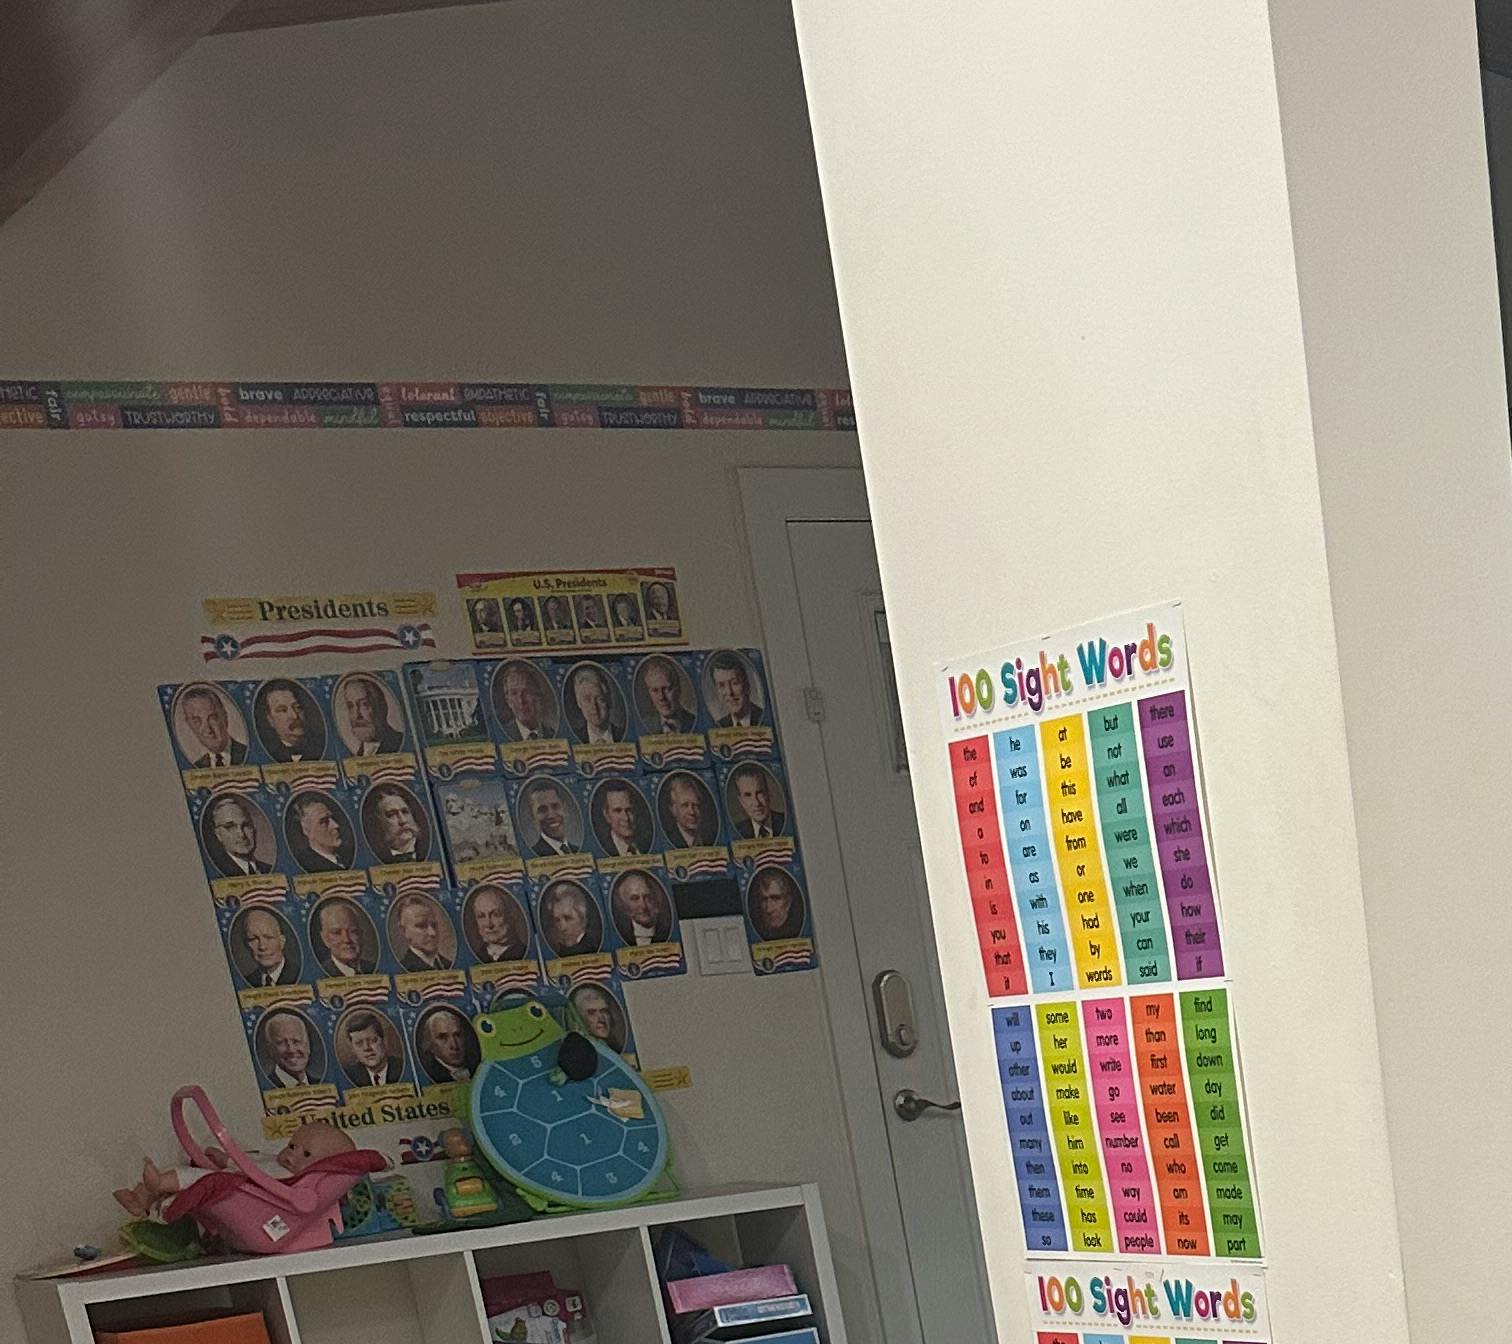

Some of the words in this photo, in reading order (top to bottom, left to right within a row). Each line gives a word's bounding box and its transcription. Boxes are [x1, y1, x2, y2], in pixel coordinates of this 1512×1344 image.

[239, 385, 283, 401] brave
[401, 385, 457, 402] tolerant
[699, 390, 736, 405] brave
[404, 408, 477, 427] respectful
[532, 578, 553, 590] U.S.
[555, 577, 608, 590] Presidents
[258, 599, 390, 622] Presidents
[947, 667, 994, 718] 100
[1000, 649, 1072, 713] Sight
[1076, 623, 1173, 686] Words
[1104, 715, 1118, 731] but
[1009, 737, 1020, 751] he
[1107, 743, 1121, 759] not
[1107, 770, 1129, 787] what
[1016, 790, 1027, 805] for
[969, 797, 984, 814] and
[1061, 809, 1083, 824] have
[1163, 815, 1192, 835] which
[1066, 835, 1086, 851] from
[1114, 829, 1138, 843] were
[1123, 881, 1148, 896] when
[1078, 891, 1094, 903] one
[1180, 903, 1201, 917] how
[1081, 913, 1099, 929] had
[1130, 911, 1150, 928] your
[991, 930, 1006, 944] you
[1137, 938, 1153, 950] can
[1039, 946, 1056, 963] they
[1089, 941, 1100, 959] by
[1086, 966, 1112, 982] words
[1139, 960, 1158, 977] said
[1194, 996, 1212, 1013] find
[1046, 1013, 1069, 1024] some
[1096, 1007, 1112, 1020] two
[1096, 1035, 1118, 1046] more
[1145, 1028, 1166, 1042] than
[1195, 1025, 1216, 1043] long
[1053, 1035, 1067, 1049] her
[1051, 1059, 1077, 1074] would
[1150, 1054, 1167, 1069] first
[1197, 1052, 1223, 1067] down
[1056, 1085, 1079, 1099] make
[1205, 1079, 1221, 1097] day
[380, 1100, 450, 1124] States
[1155, 1108, 1179, 1123] been
[1105, 1134, 1138, 1148] number
[1164, 1133, 1180, 1148] call
[1214, 1133, 1229, 1151] get
[1166, 1159, 1186, 1174] who
[1216, 1184, 1242, 1199] made
[1083, 1233, 1102, 1247] look
[1124, 1233, 1154, 1253] people
[1227, 1238, 1246, 1254] part
[1037, 1275, 1084, 1314] 100
[1089, 1274, 1158, 1326] Sight
[1163, 1278, 1256, 1321] Words
